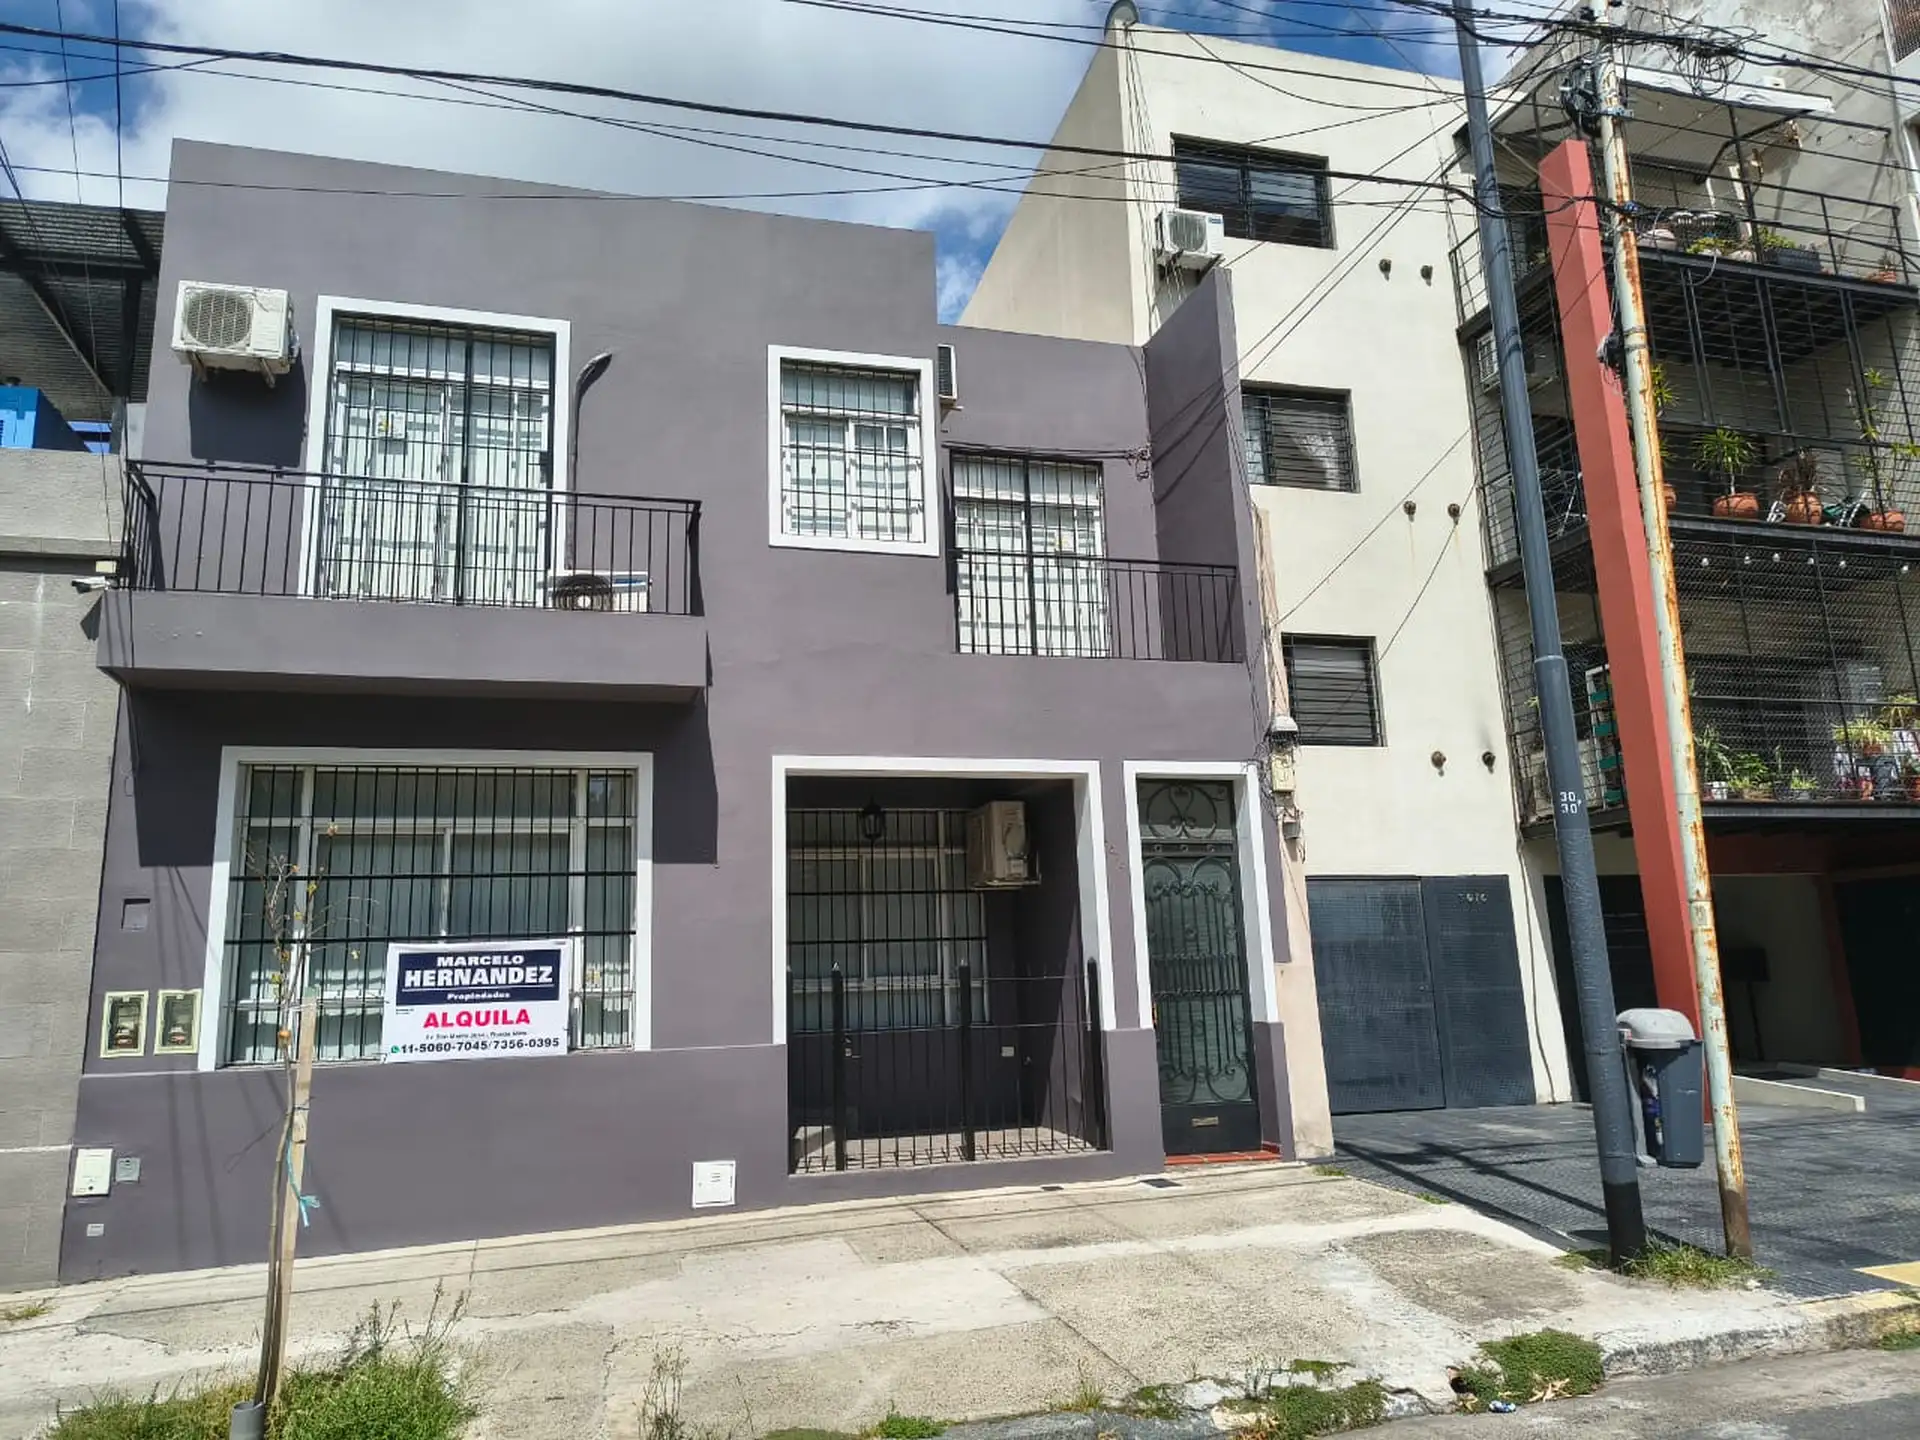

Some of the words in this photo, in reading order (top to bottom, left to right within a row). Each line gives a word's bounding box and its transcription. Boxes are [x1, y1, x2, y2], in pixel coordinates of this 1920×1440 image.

[436, 955, 524, 967] MARCELO
[404, 966, 553, 988] HERNANDEZ
[423, 1008, 531, 1029] ALQUILA
